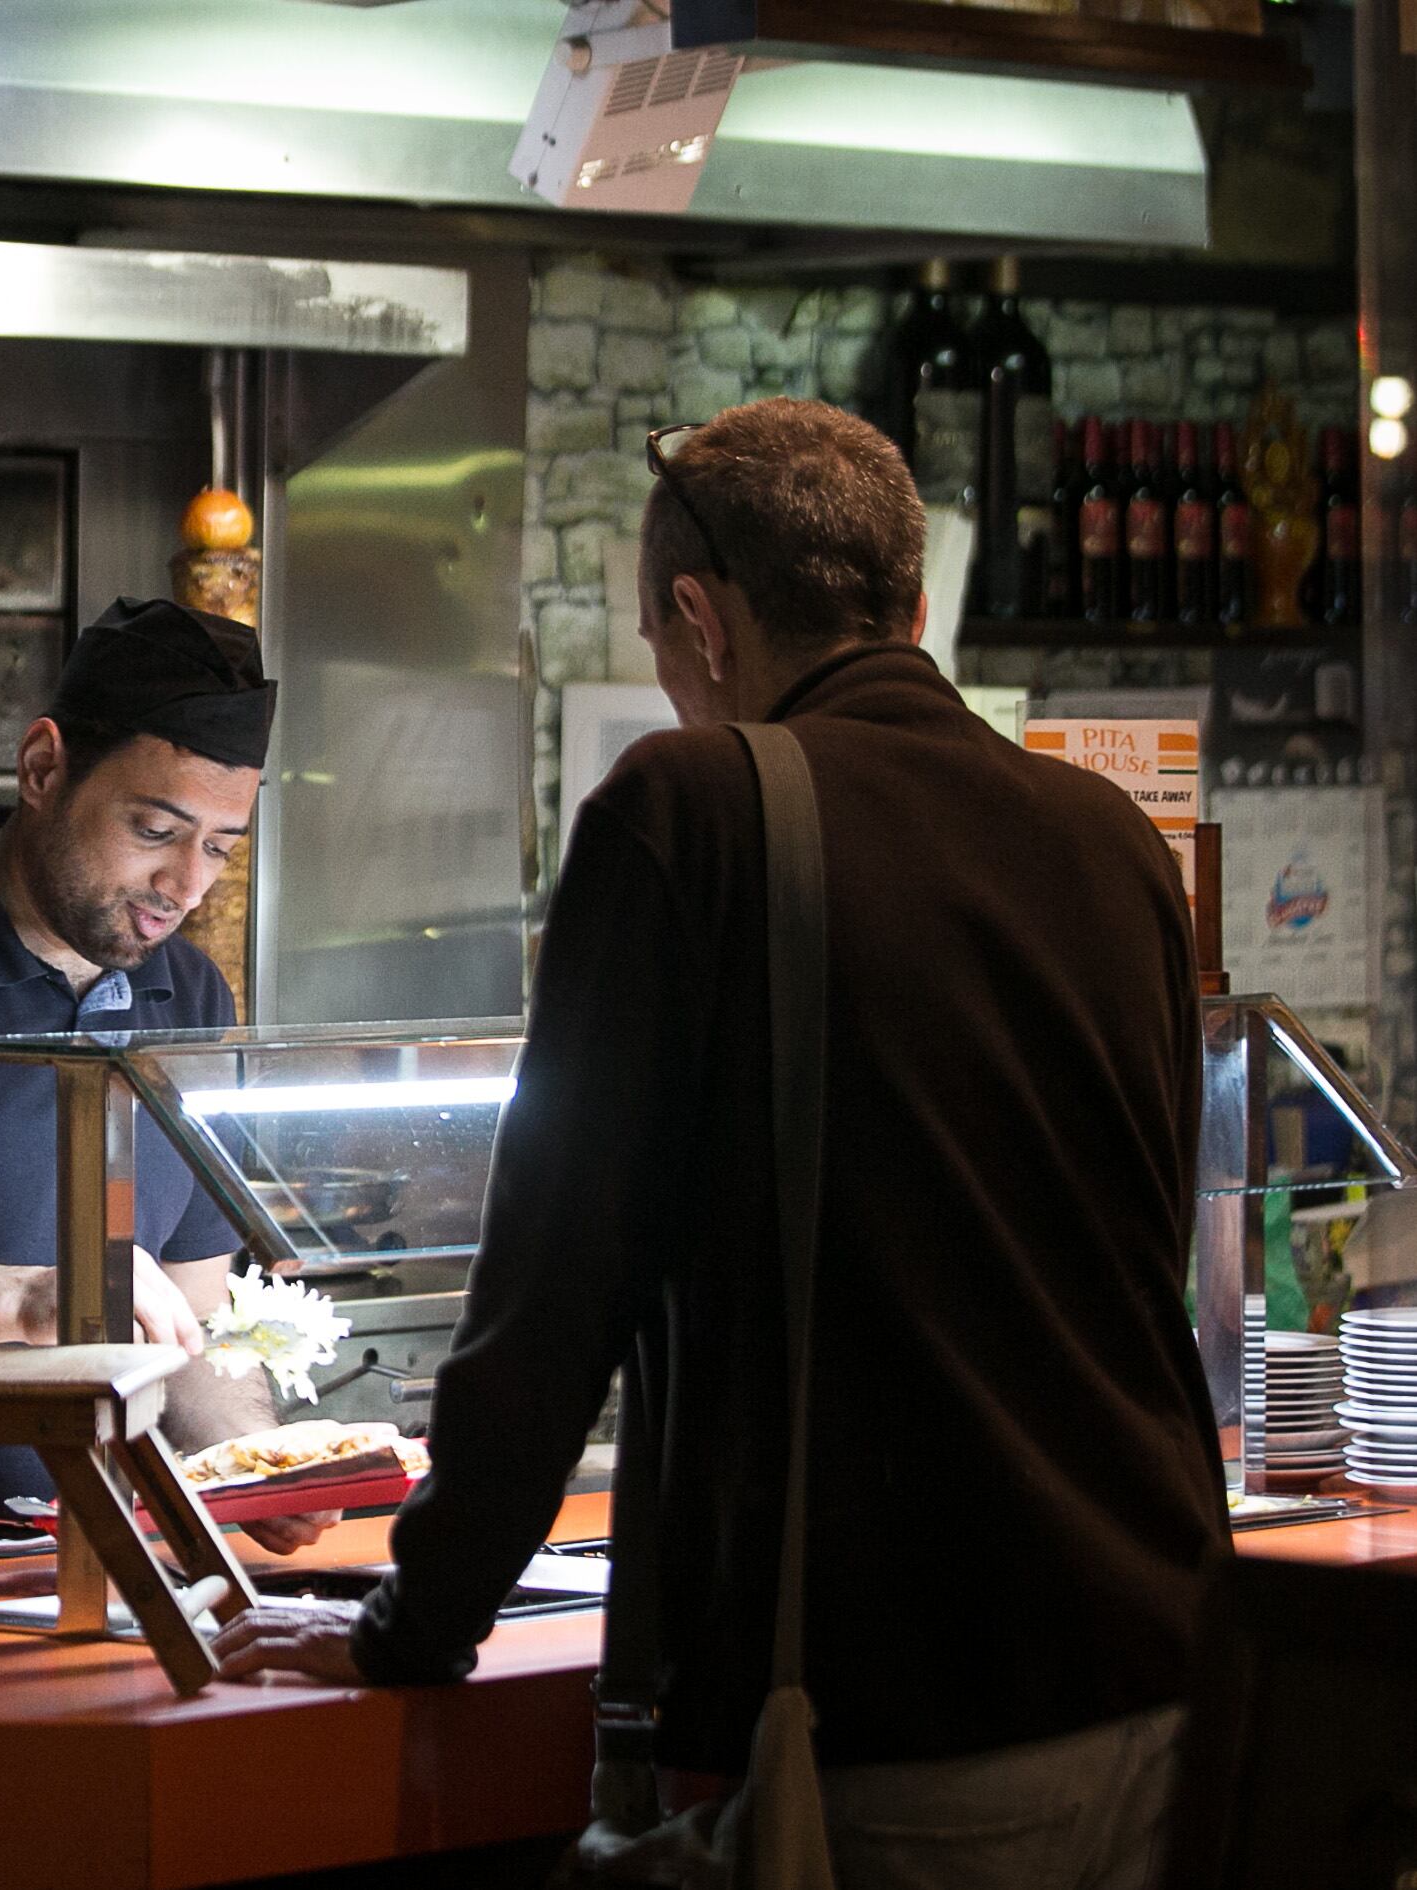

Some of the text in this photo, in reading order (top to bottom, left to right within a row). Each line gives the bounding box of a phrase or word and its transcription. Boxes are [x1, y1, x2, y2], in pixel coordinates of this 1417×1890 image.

[1083, 728, 1135, 752] PITA
[1072, 752, 1153, 776] HOUSE
[1133, 791, 1159, 802] TAKE
[1161, 791, 1192, 803] AWAY
